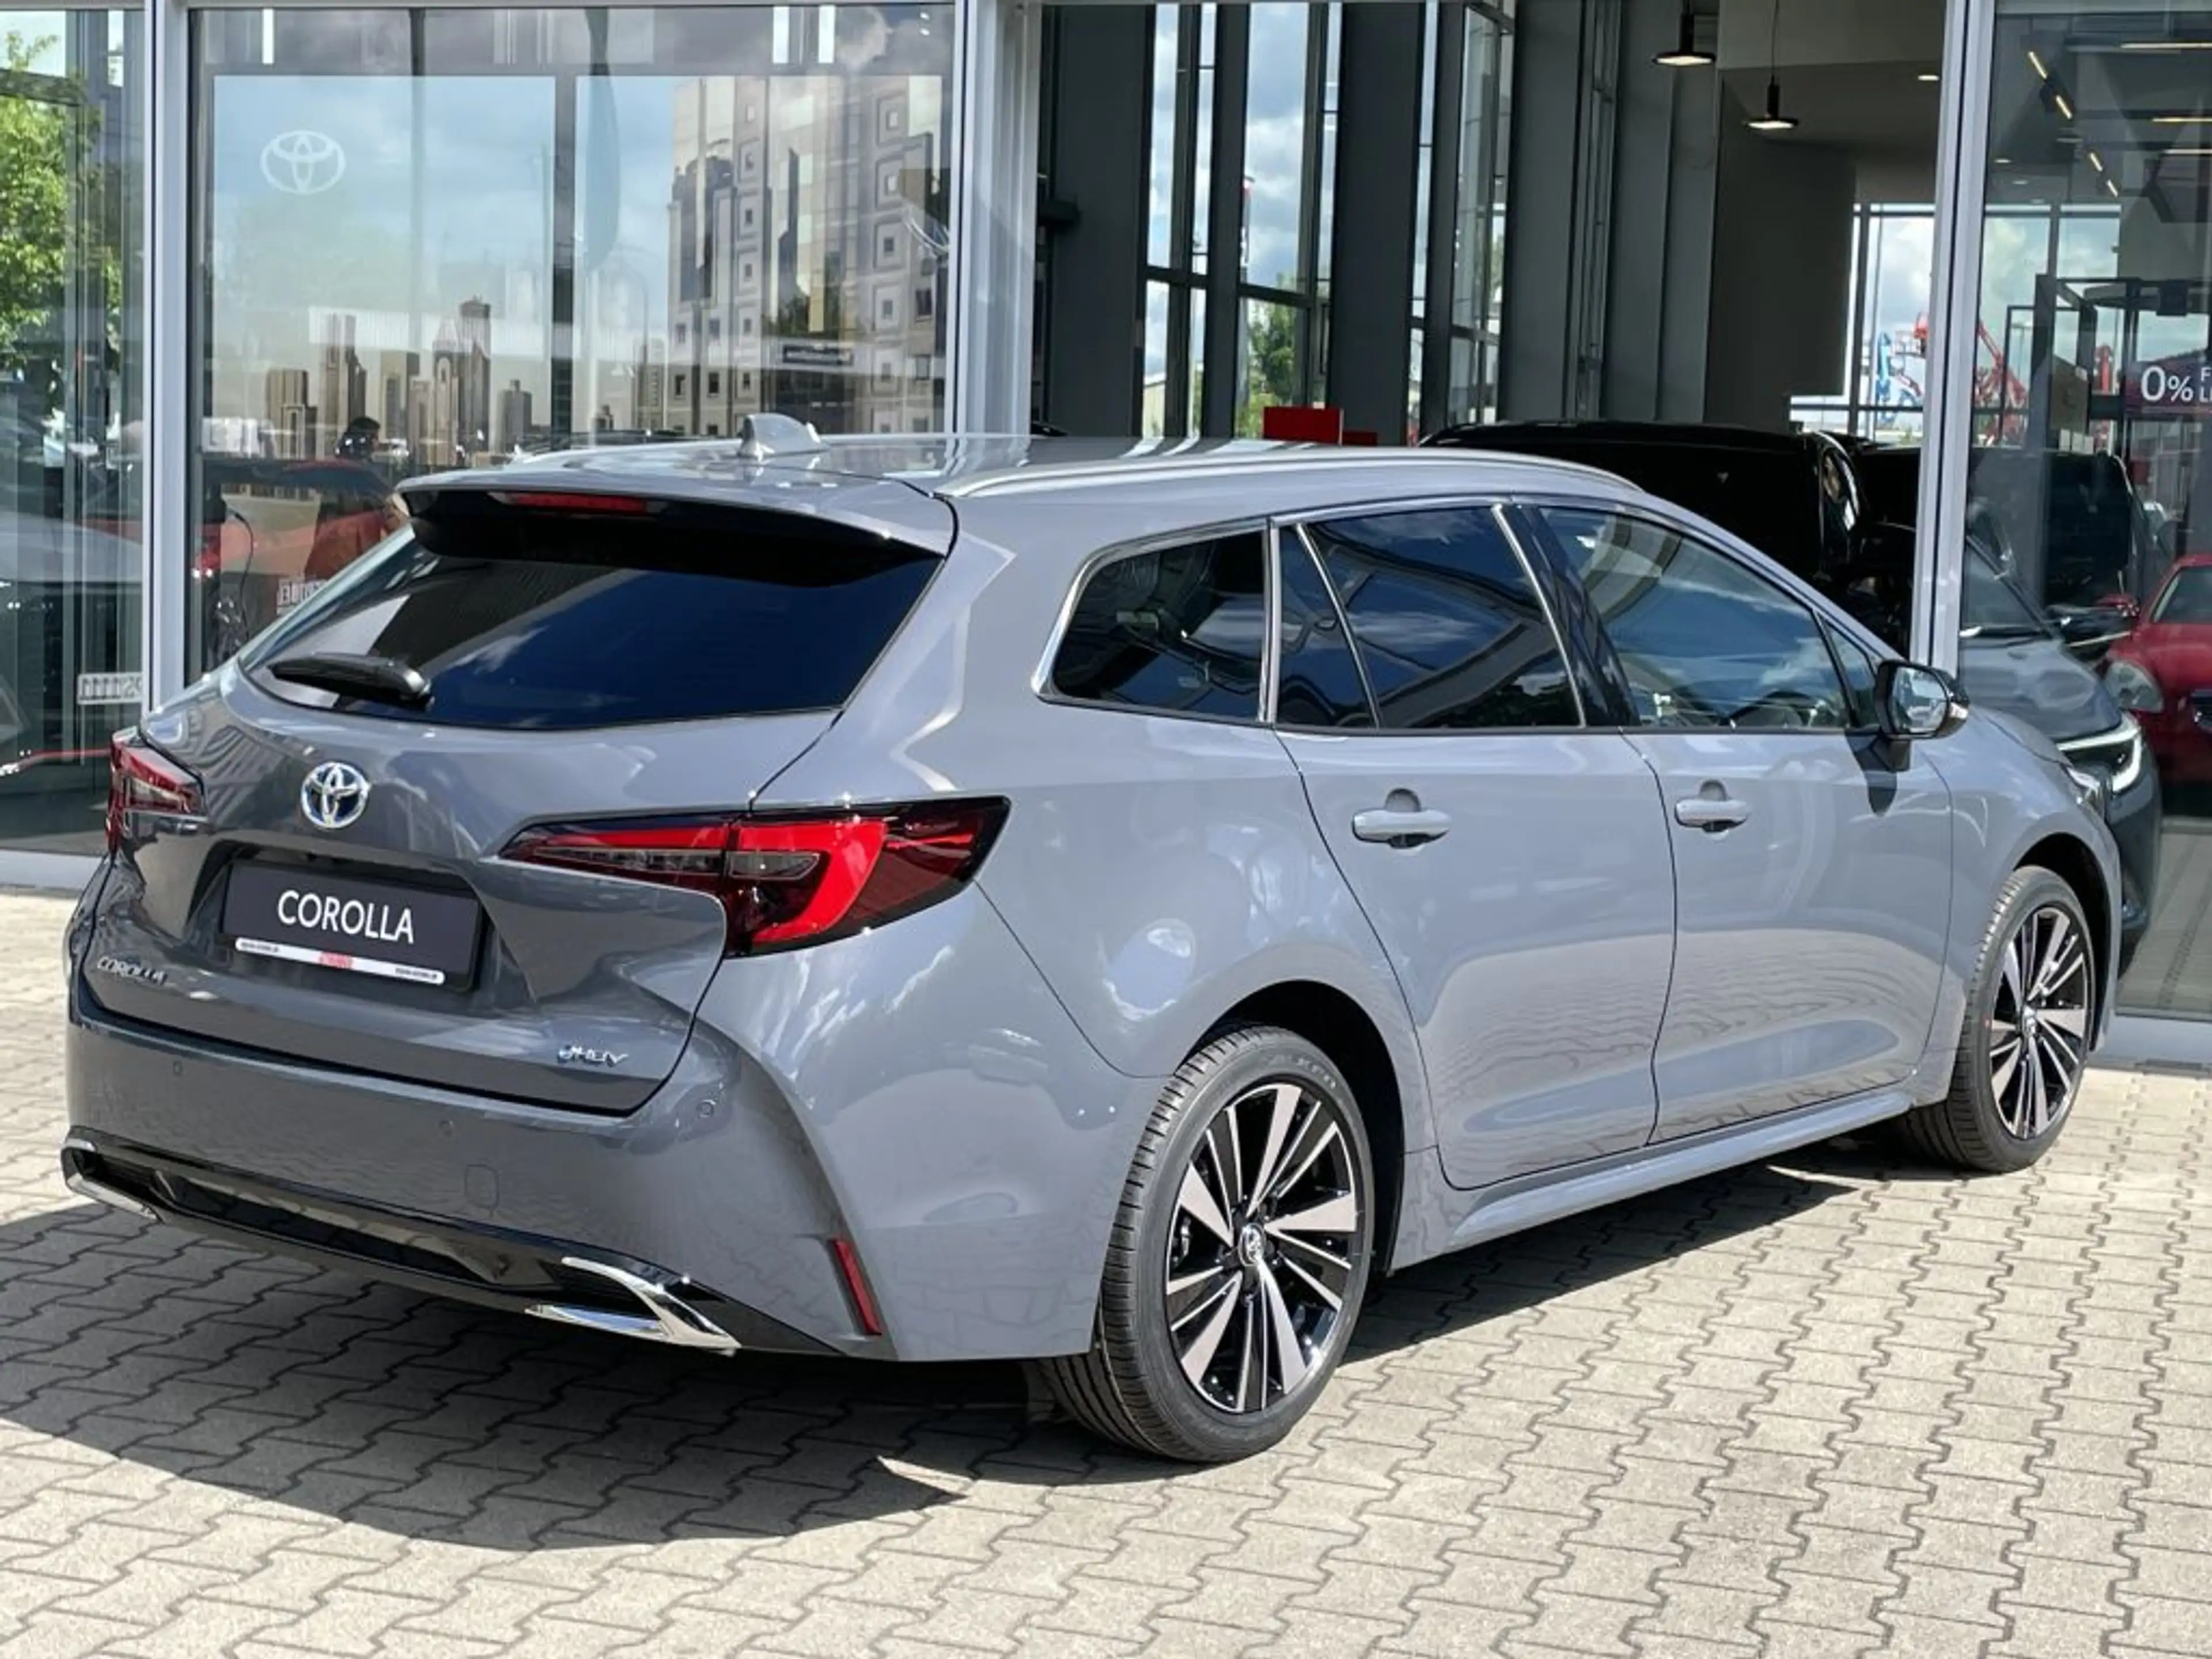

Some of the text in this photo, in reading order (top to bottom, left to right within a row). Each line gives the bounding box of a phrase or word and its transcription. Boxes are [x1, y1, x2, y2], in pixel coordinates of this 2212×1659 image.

[2141, 366, 2194, 402] 0%
[278, 889, 414, 944] COROLLA
[97, 956, 168, 986] COROLLA
